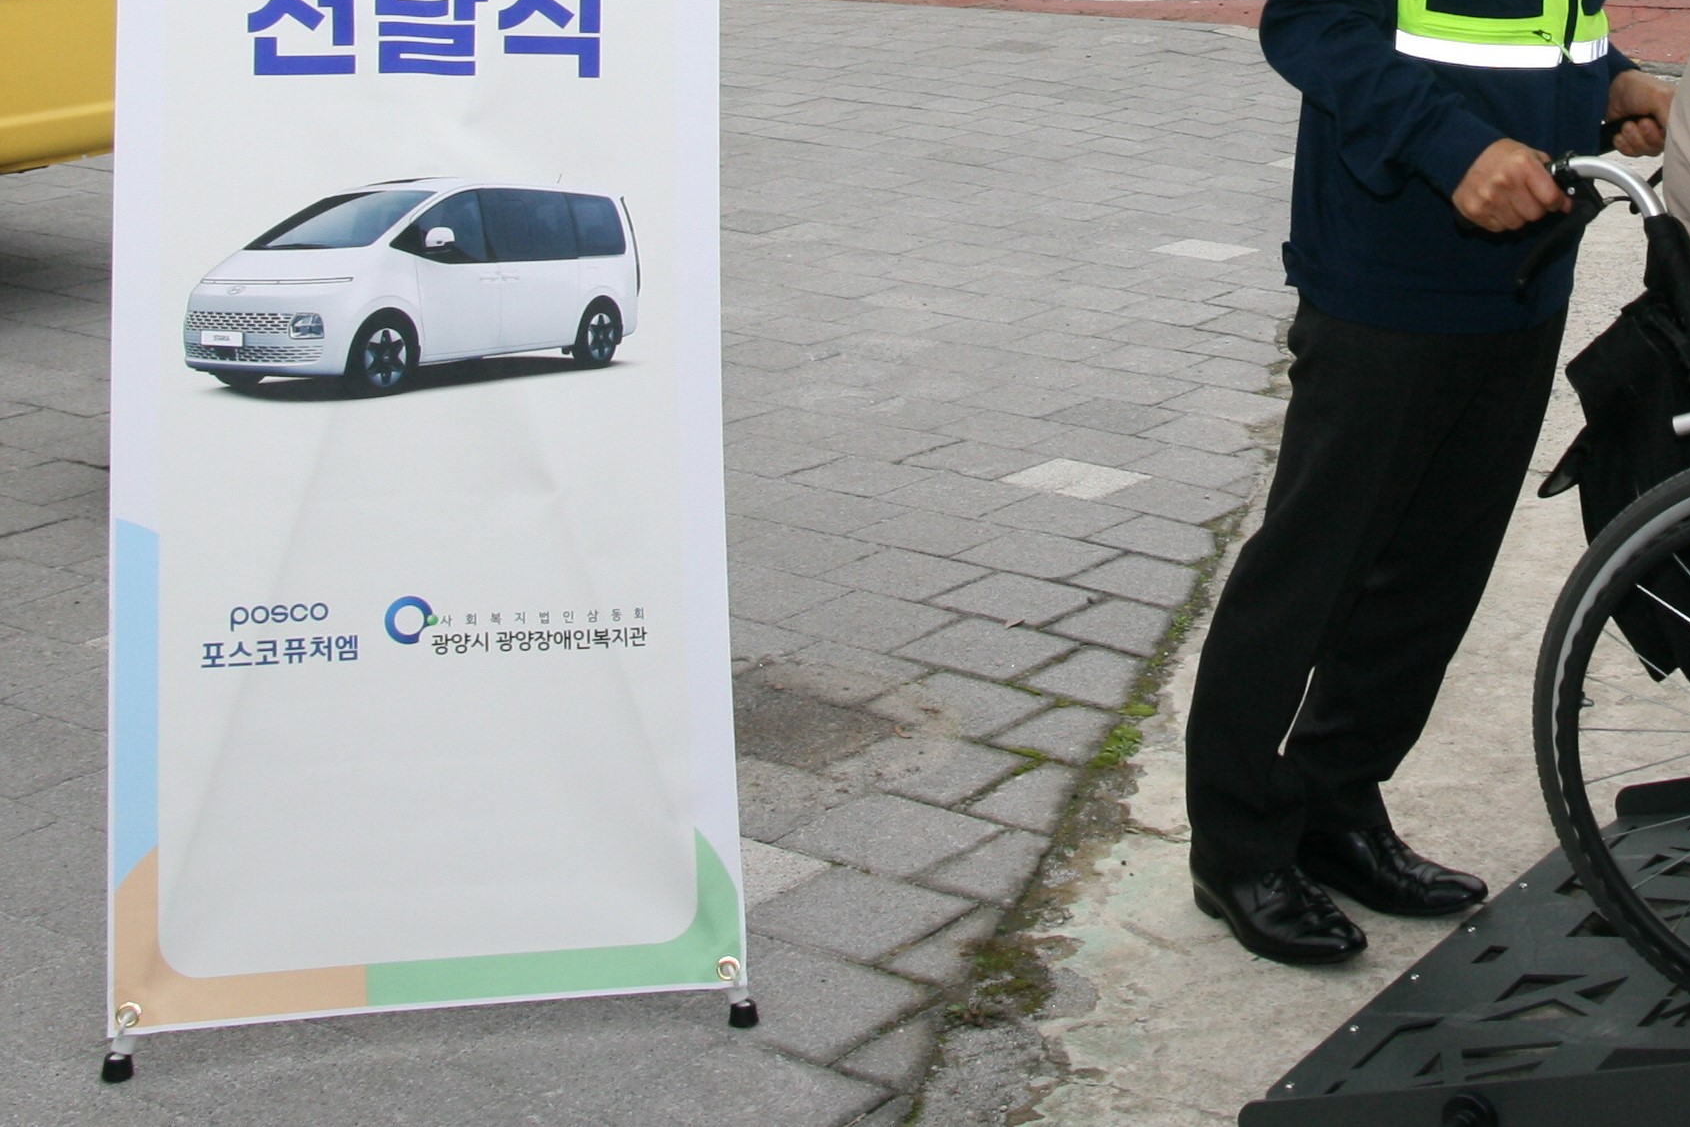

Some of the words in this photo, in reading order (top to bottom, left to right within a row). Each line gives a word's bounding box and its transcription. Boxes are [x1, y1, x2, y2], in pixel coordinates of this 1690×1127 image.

[230, 602, 329, 632] posco
[200, 634, 360, 669] 포스코퓨처엠
[431, 631, 490, 655] 광양시
[495, 627, 648, 653] 광양장애인복지관
